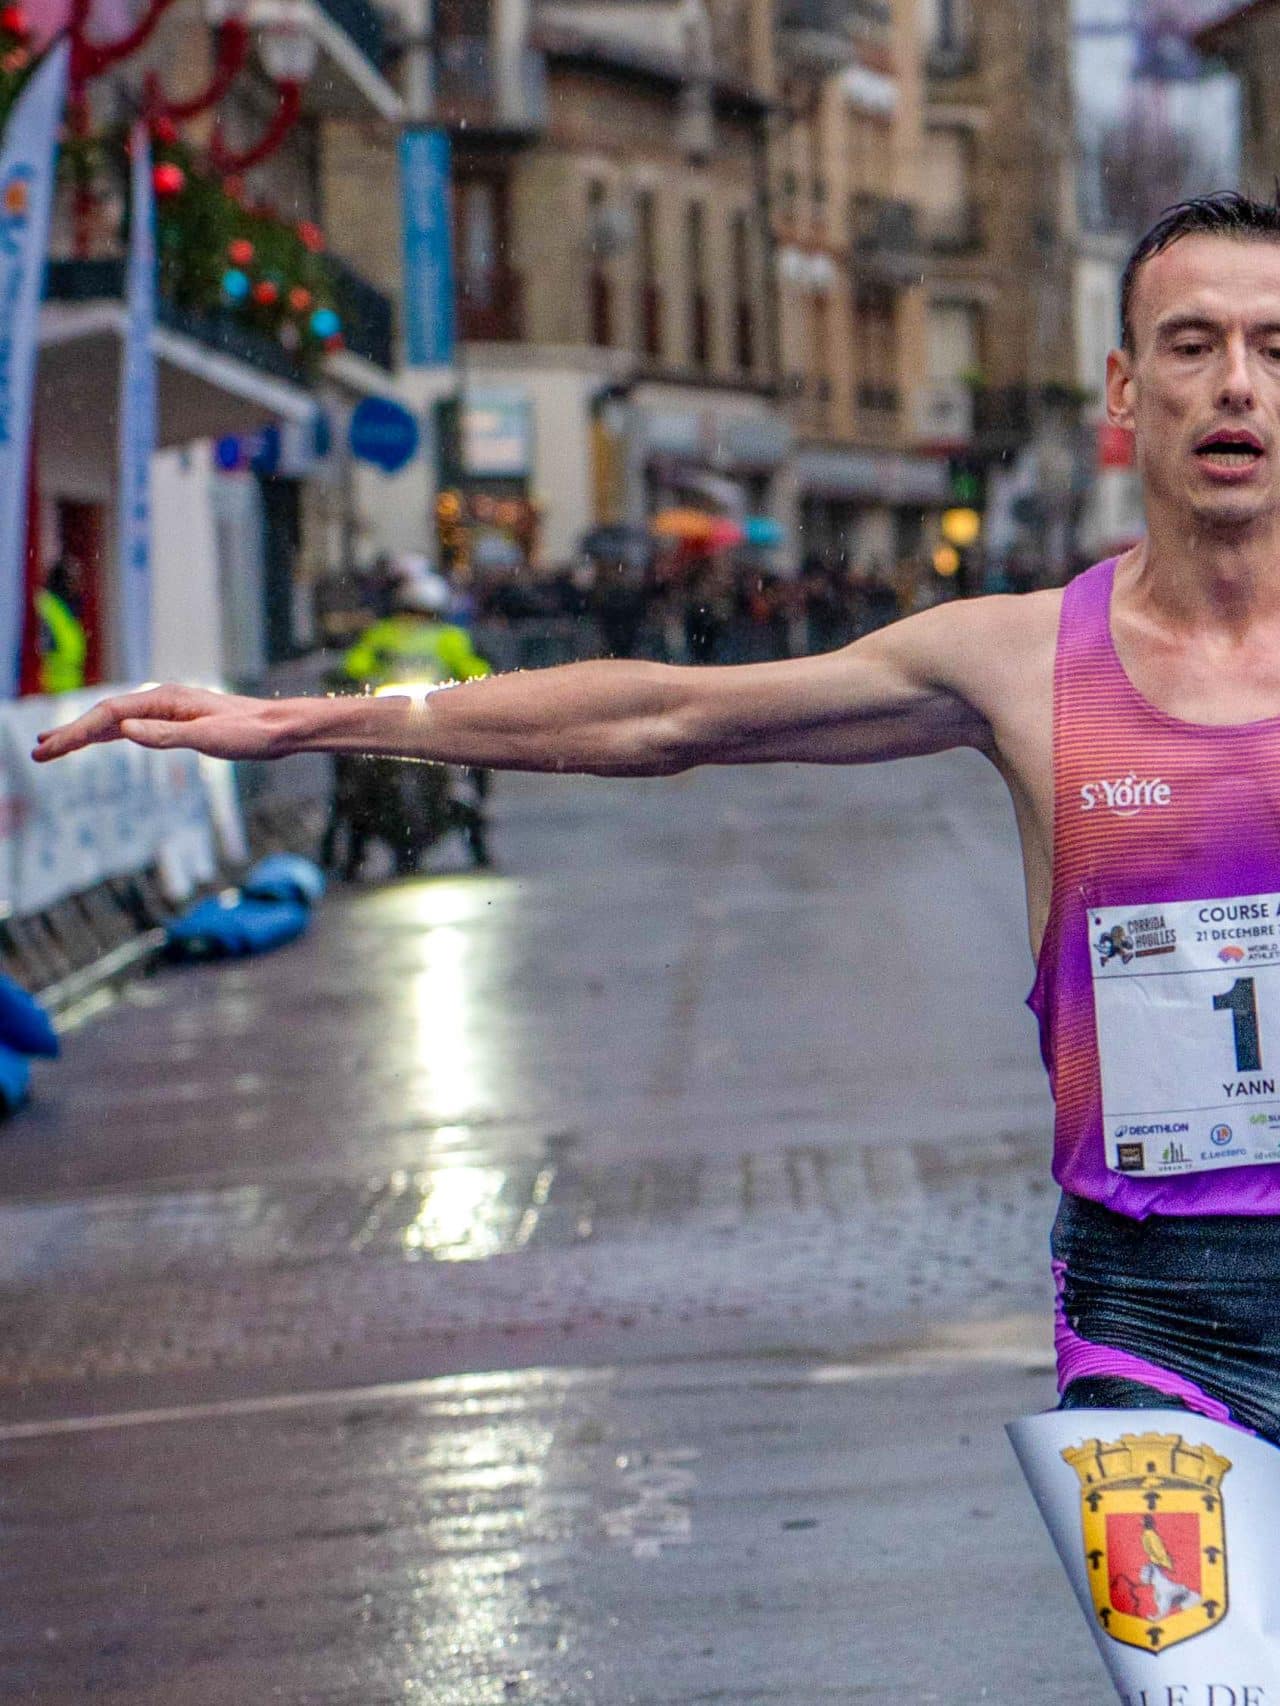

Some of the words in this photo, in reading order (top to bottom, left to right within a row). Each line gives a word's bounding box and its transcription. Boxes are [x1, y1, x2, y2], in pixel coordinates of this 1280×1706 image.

[1199, 904, 1269, 923] COURSE
[1196, 931, 1208, 942] 21
[1212, 925, 1275, 940] DECEMBRE
[1212, 977, 1262, 1072] 1
[1222, 1080, 1275, 1098] YANN
[1129, 1123, 1189, 1135] DECATHLON
